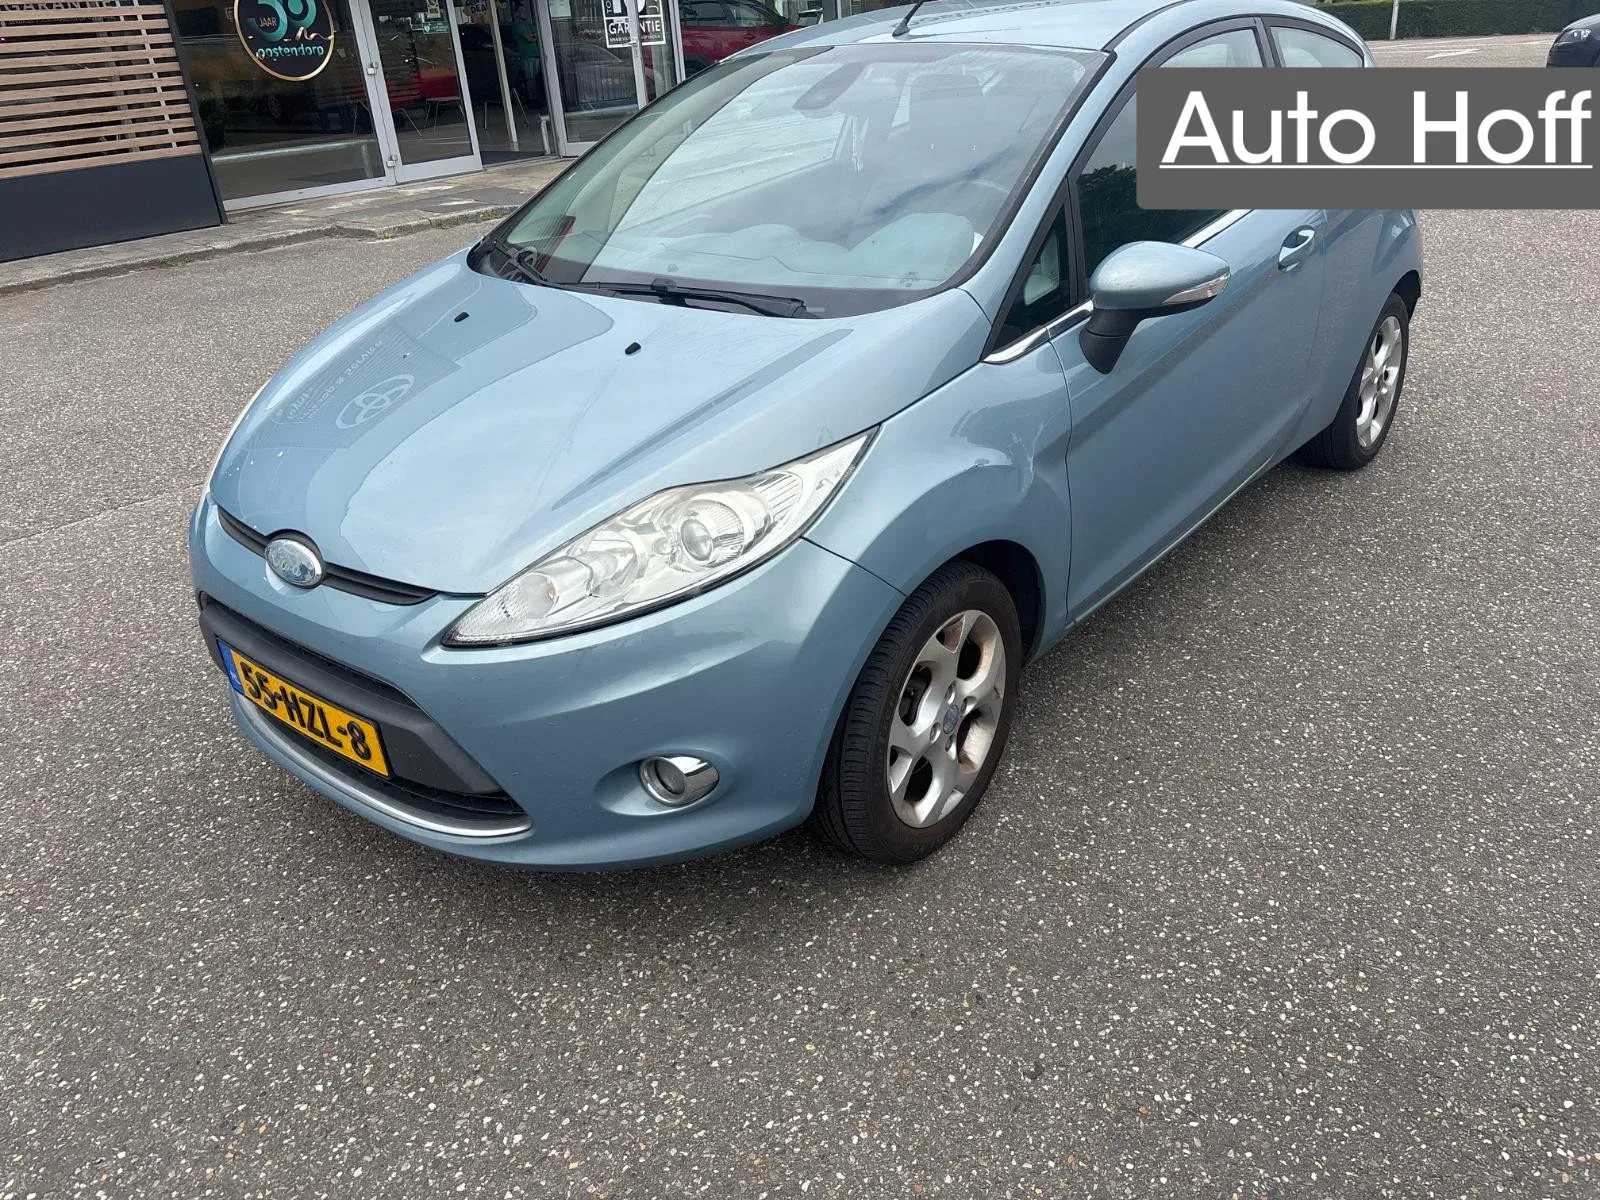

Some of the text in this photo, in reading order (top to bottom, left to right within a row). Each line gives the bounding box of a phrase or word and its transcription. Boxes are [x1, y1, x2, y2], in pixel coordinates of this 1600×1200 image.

[260, 17, 278, 28] JAAR
[608, 20, 661, 35] GARNTIE
[257, 43, 324, 58] oostendorp
[239, 660, 372, 761] 55-HZL-8
